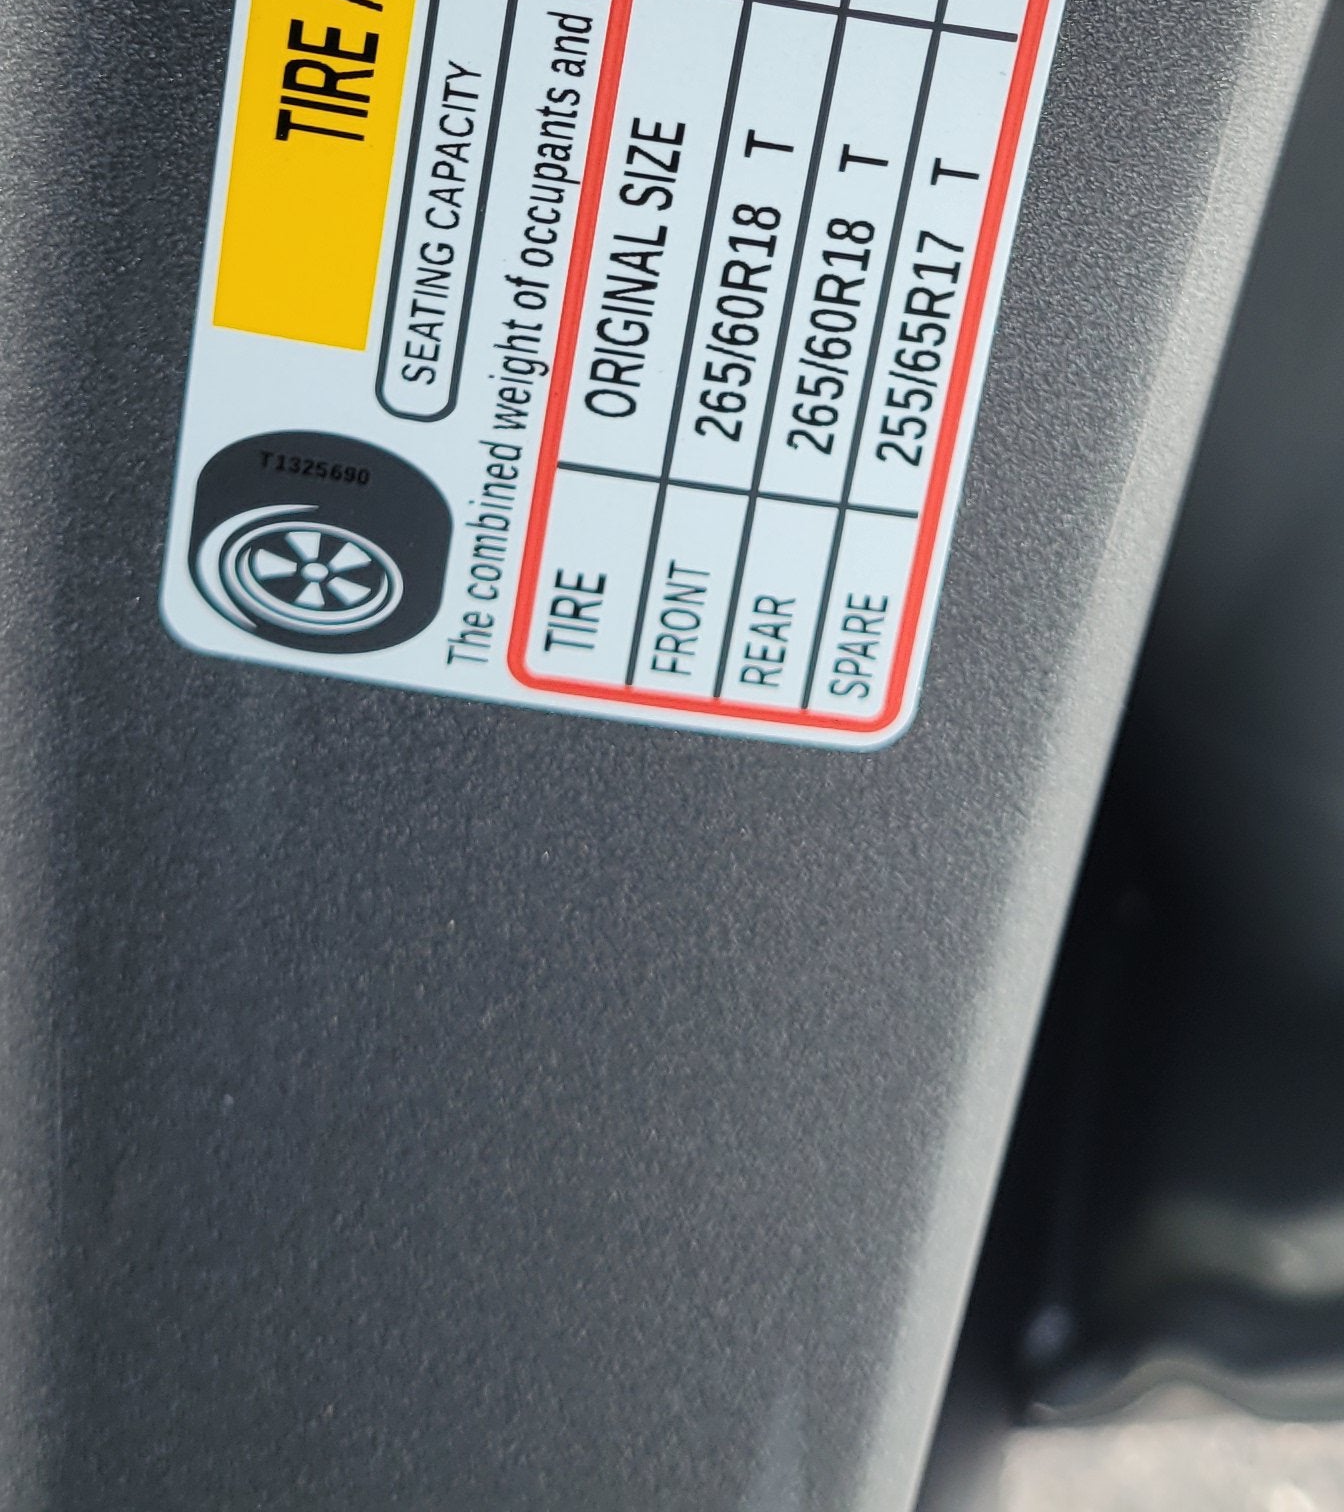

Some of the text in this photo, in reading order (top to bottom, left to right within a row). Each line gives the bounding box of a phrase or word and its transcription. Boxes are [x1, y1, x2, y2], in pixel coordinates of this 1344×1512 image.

[274, 18, 380, 142] TIRE
[546, 11, 594, 78] and
[424, 60, 482, 230] CAPACITY
[520, 87, 581, 268] occupants
[618, 117, 686, 212] SIZE
[400, 241, 455, 385] SEATING
[504, 274, 550, 311] of
[583, 225, 668, 418] ORIGINAL
[492, 318, 550, 430] weight
[650, 559, 710, 676] FRONT
[694, 203, 782, 442] 265/60R18
[743, 128, 795, 159] T
[739, 596, 796, 687] REAR
[786, 217, 876, 455] 265/60R18
[838, 143, 889, 173] T
[829, 593, 889, 699] SPARE
[875, 230, 965, 467] 255/65R17
[930, 157, 980, 186] T
[259, 450, 371, 486] T1325690
[465, 440, 523, 601] combined
[446, 611, 495, 666] The
[543, 569, 607, 652] TIRE
